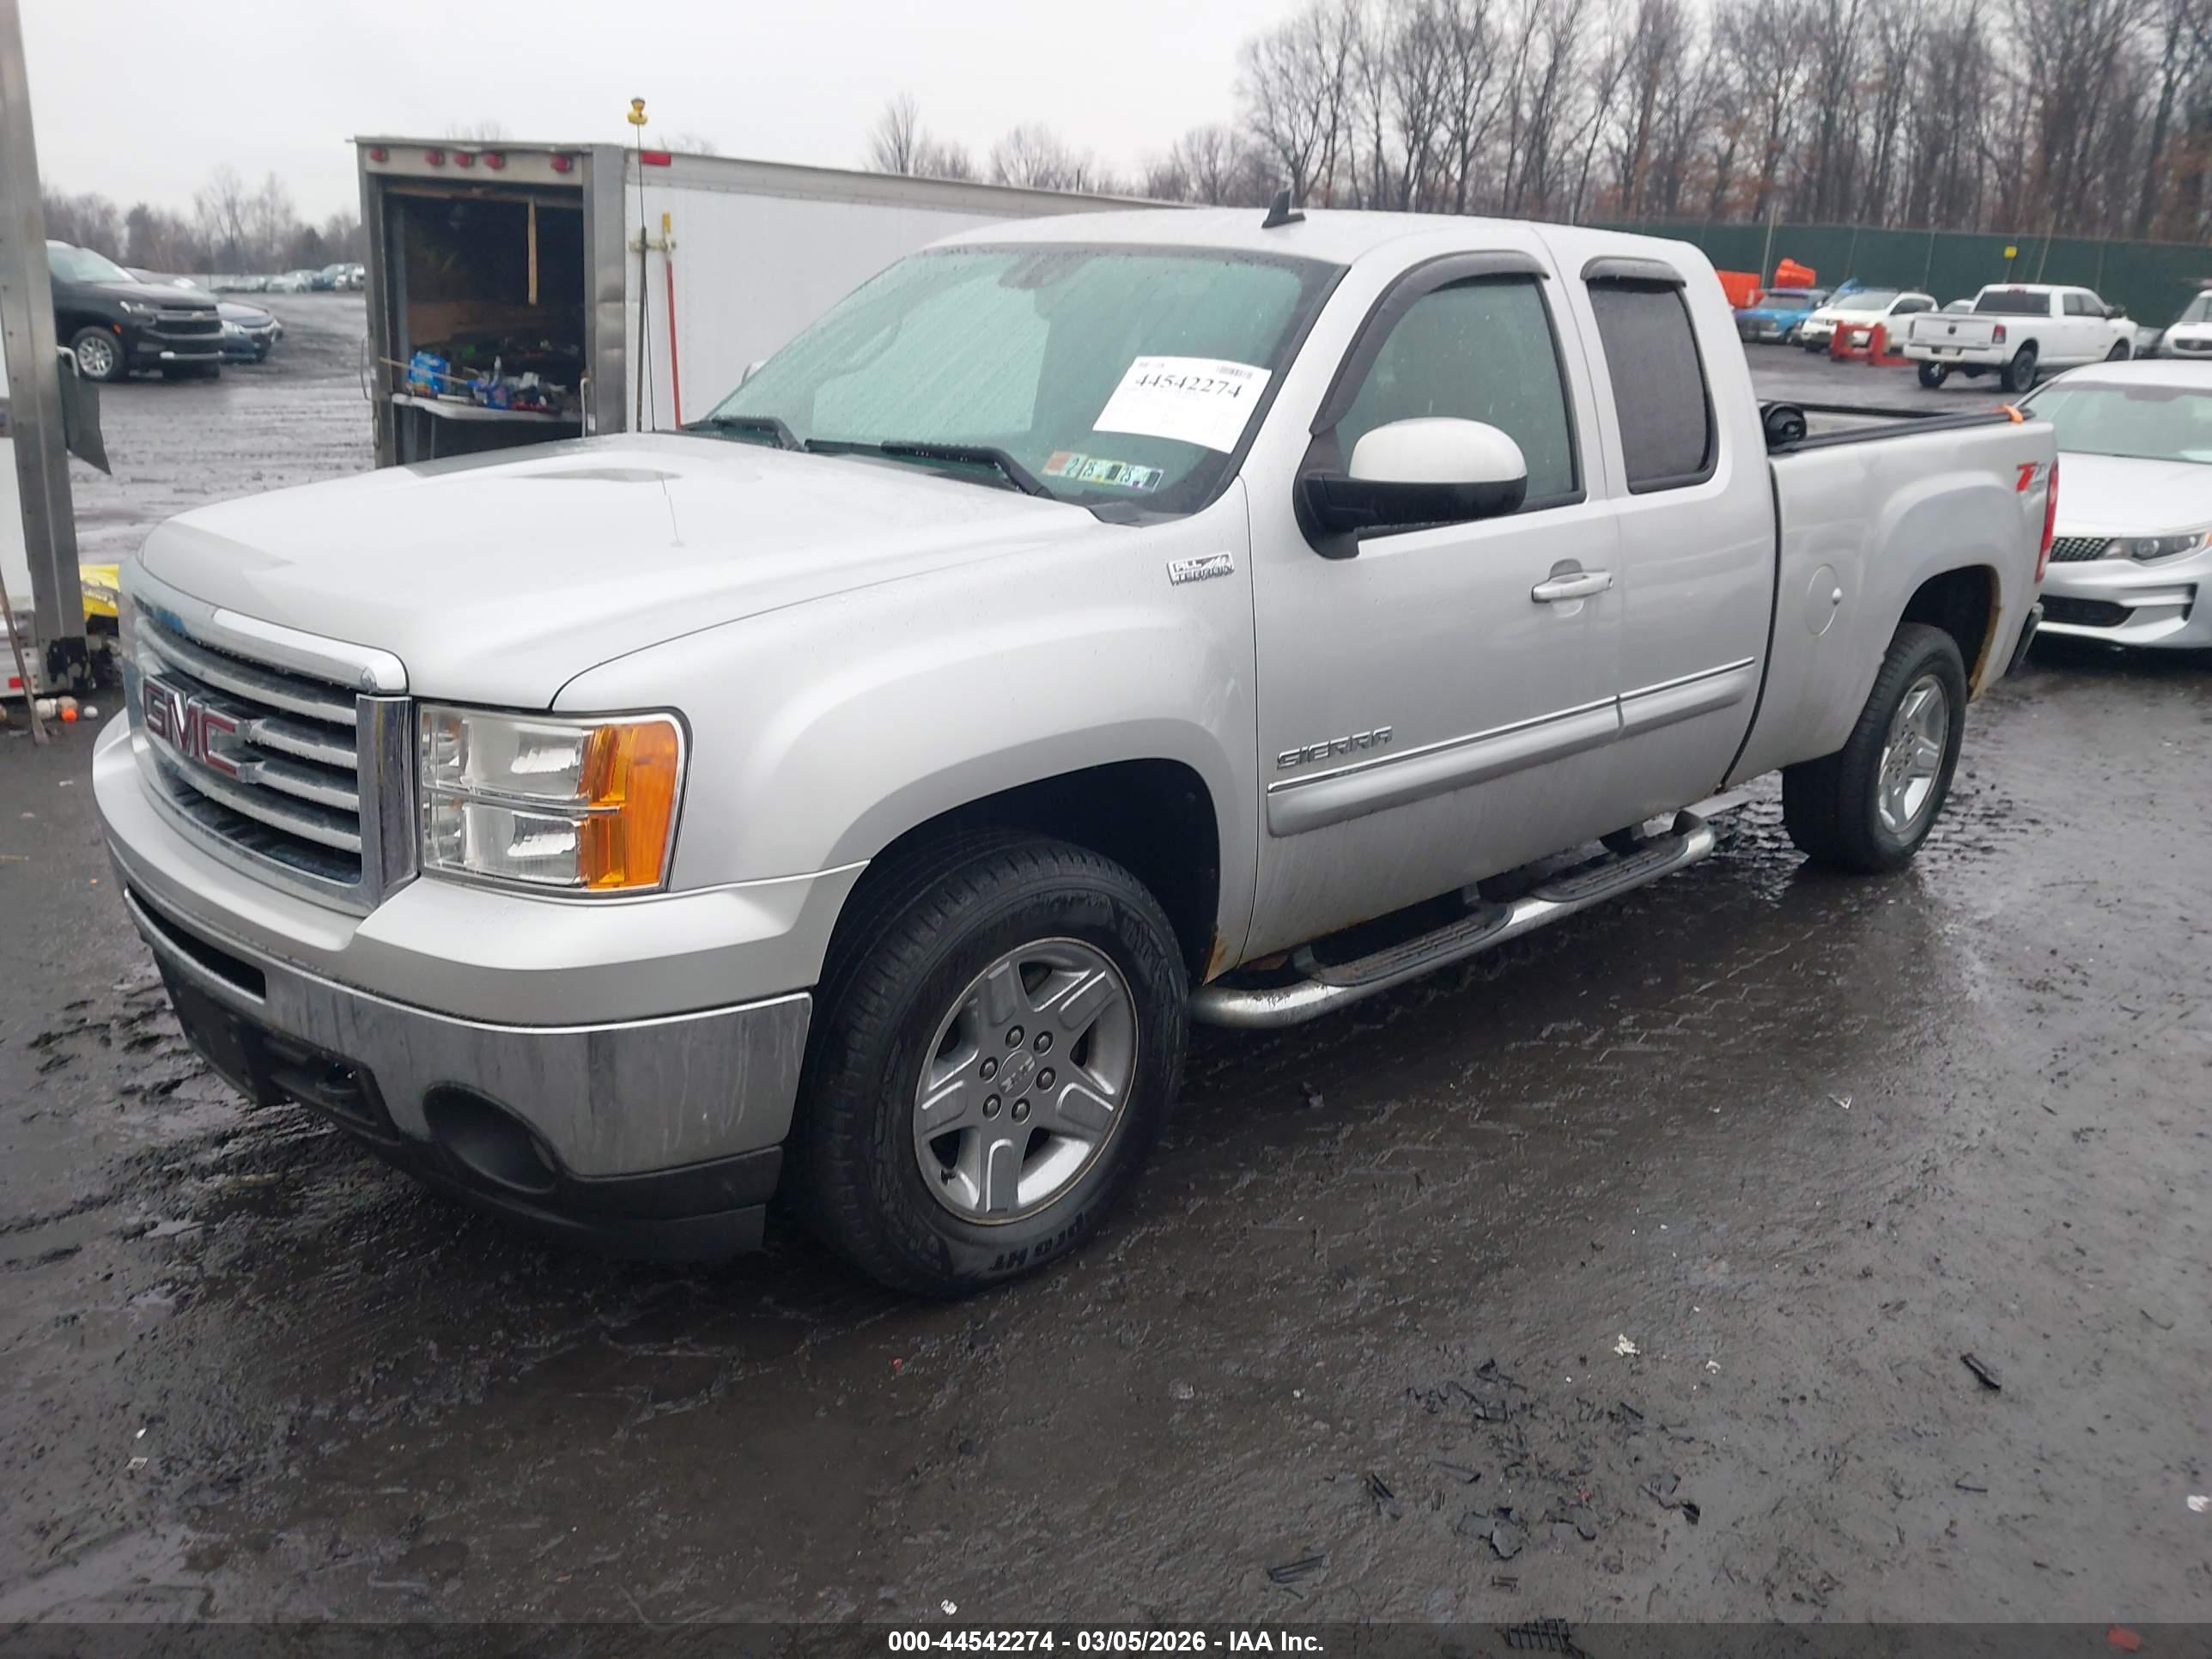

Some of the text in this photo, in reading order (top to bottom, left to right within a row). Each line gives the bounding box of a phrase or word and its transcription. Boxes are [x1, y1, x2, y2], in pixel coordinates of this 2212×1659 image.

[1134, 373, 1243, 399] 44542274
[143, 675, 247, 783] GMC
[1276, 726, 1393, 770] SIERRA
